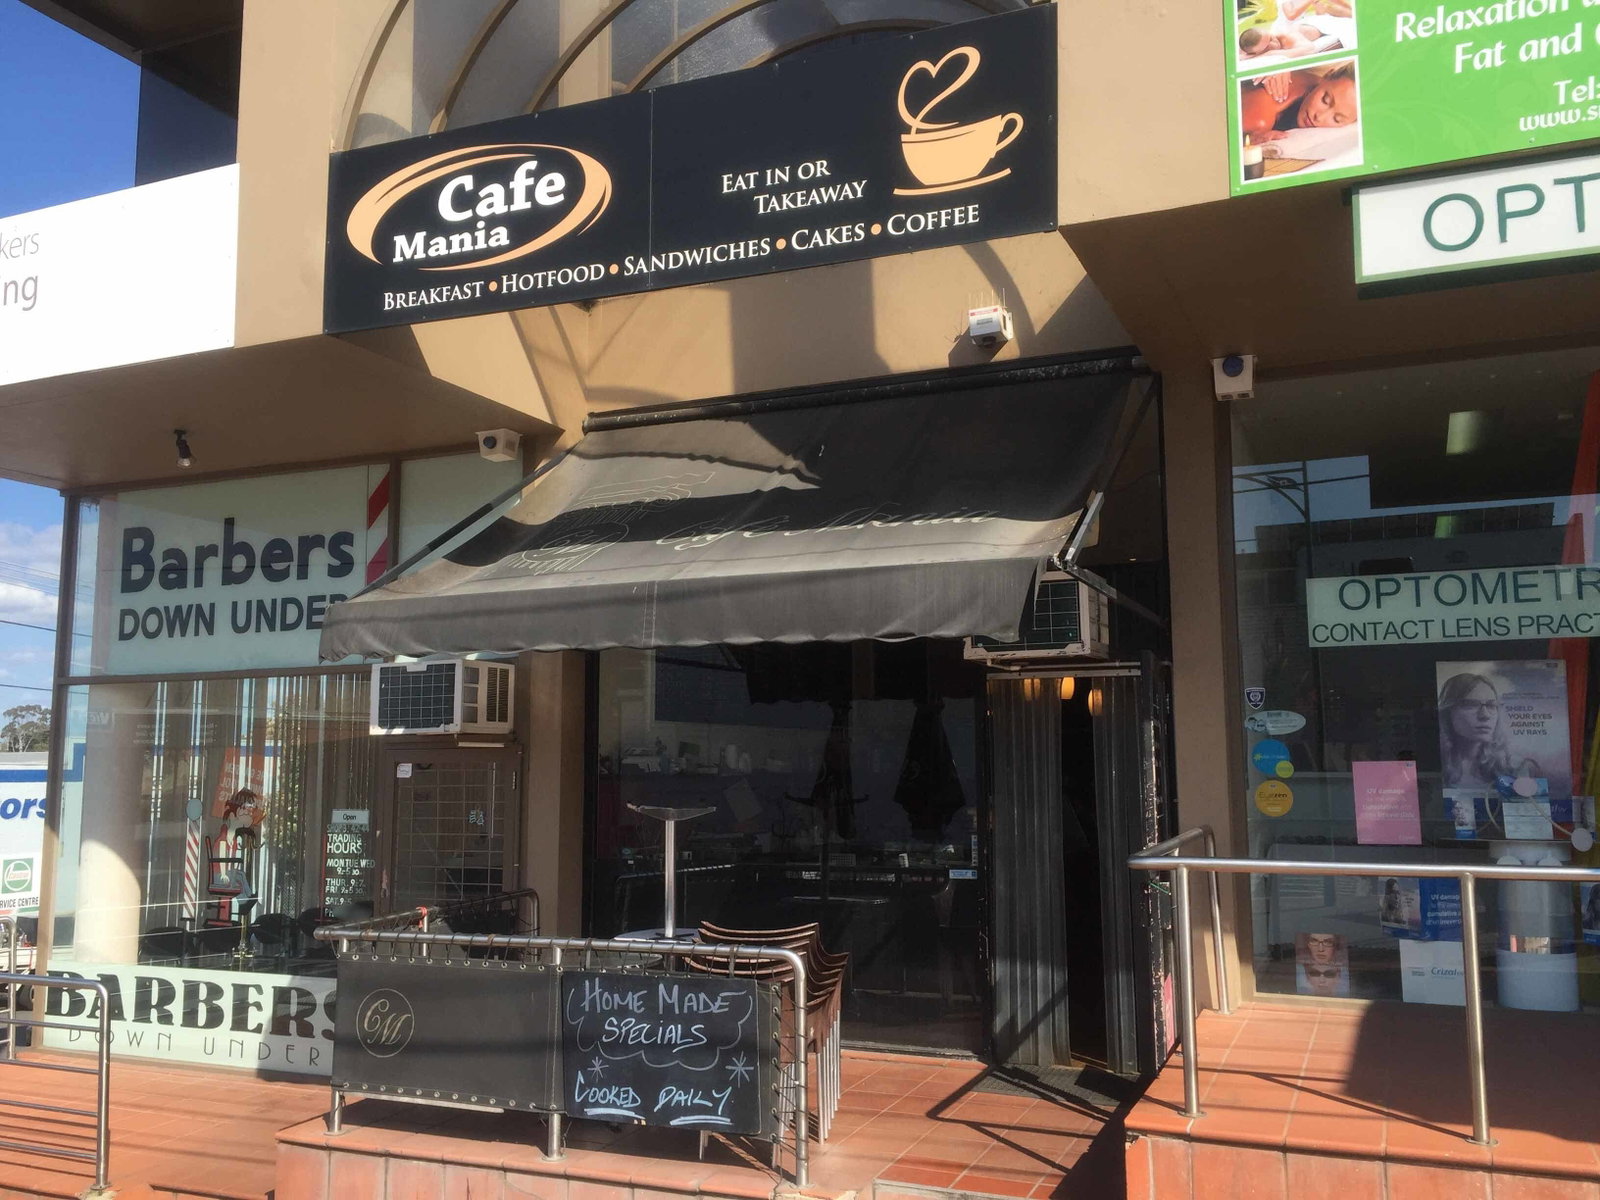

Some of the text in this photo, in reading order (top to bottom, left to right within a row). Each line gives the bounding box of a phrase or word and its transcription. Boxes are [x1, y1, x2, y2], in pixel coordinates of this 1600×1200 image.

[1395, 0, 1569, 42] Relaxation
[1454, 41, 1506, 74] Fat
[1519, 22, 1582, 62] and
[1519, 105, 1600, 131] www.s
[438, 161, 566, 222] Cafe
[721, 160, 831, 194] EAT IN OR
[754, 180, 868, 216] TAKEAWAY
[1423, 172, 1600, 253] OPT
[383, 204, 981, 311] BREAKFAST HOTFOOD SANDWICHES CAKES COFFEE
[392, 221, 510, 263] Mania
[0, 275, 38, 312] ng
[120, 517, 355, 594] Barbers
[1338, 566, 1600, 611] OPTOMETR
[118, 602, 216, 641] DOWN
[1312, 619, 1435, 643] CONTACT
[1441, 616, 1511, 639] LENS
[342, 813, 357, 821] Open
[326, 842, 363, 854] HOURS
[327, 833, 362, 843] TRADING
[17, 896, 39, 907] CENTRE
[580, 978, 747, 1015] HOME MADE
[203, 1036, 320, 1066] UNDER
